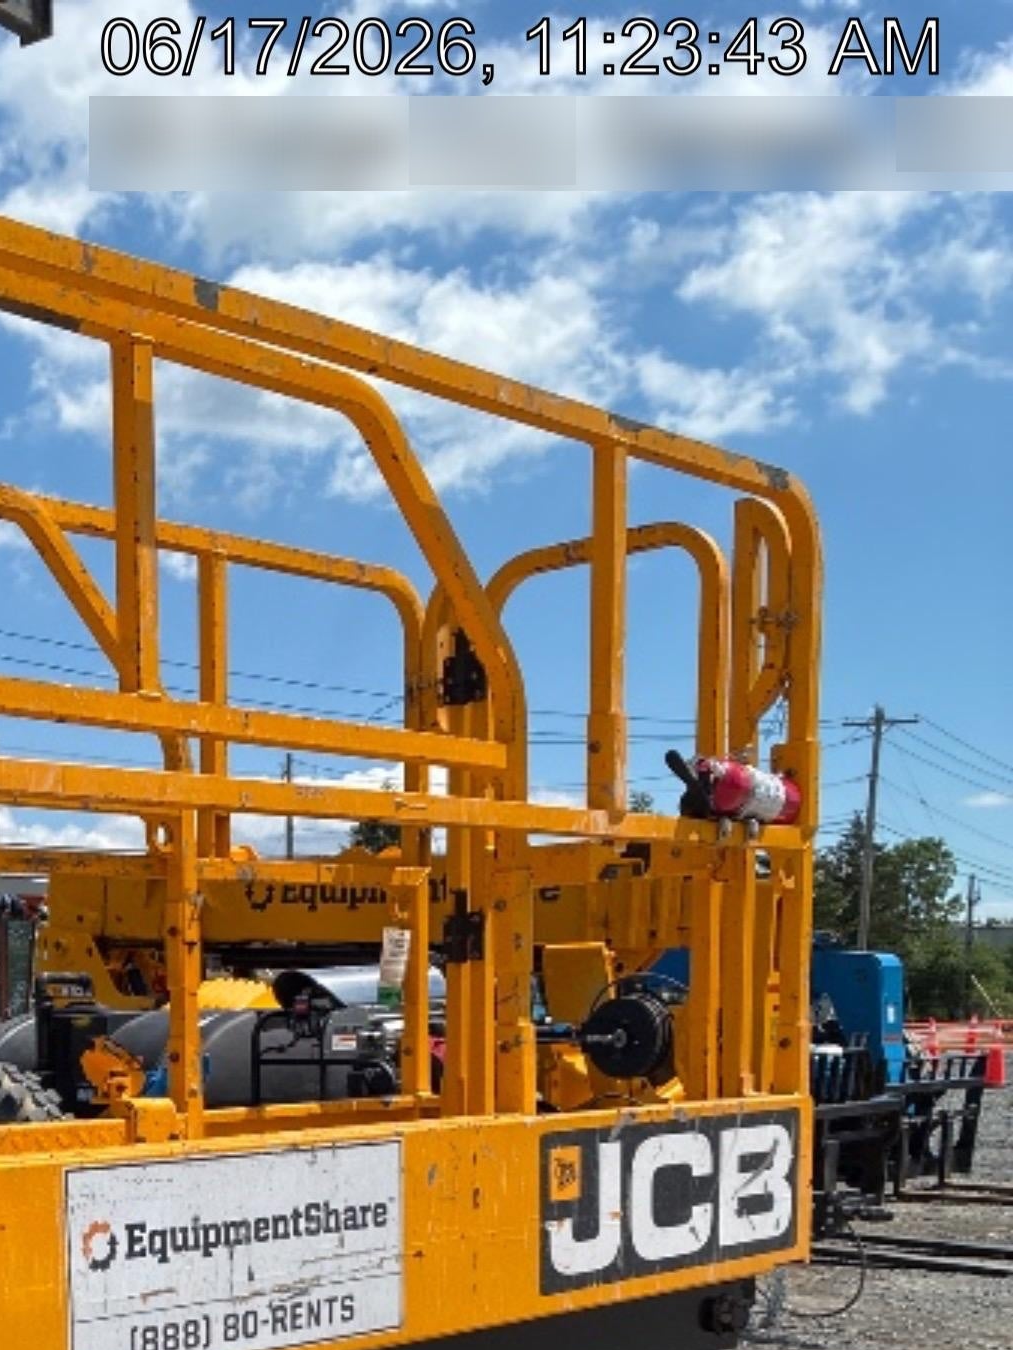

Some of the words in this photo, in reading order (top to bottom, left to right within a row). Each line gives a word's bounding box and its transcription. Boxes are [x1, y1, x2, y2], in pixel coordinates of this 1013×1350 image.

[124, 1200, 388, 1264] EquipmentShare
[545, 1124, 793, 1276] JCB
[223, 1295, 355, 1343] 80-RENTS
